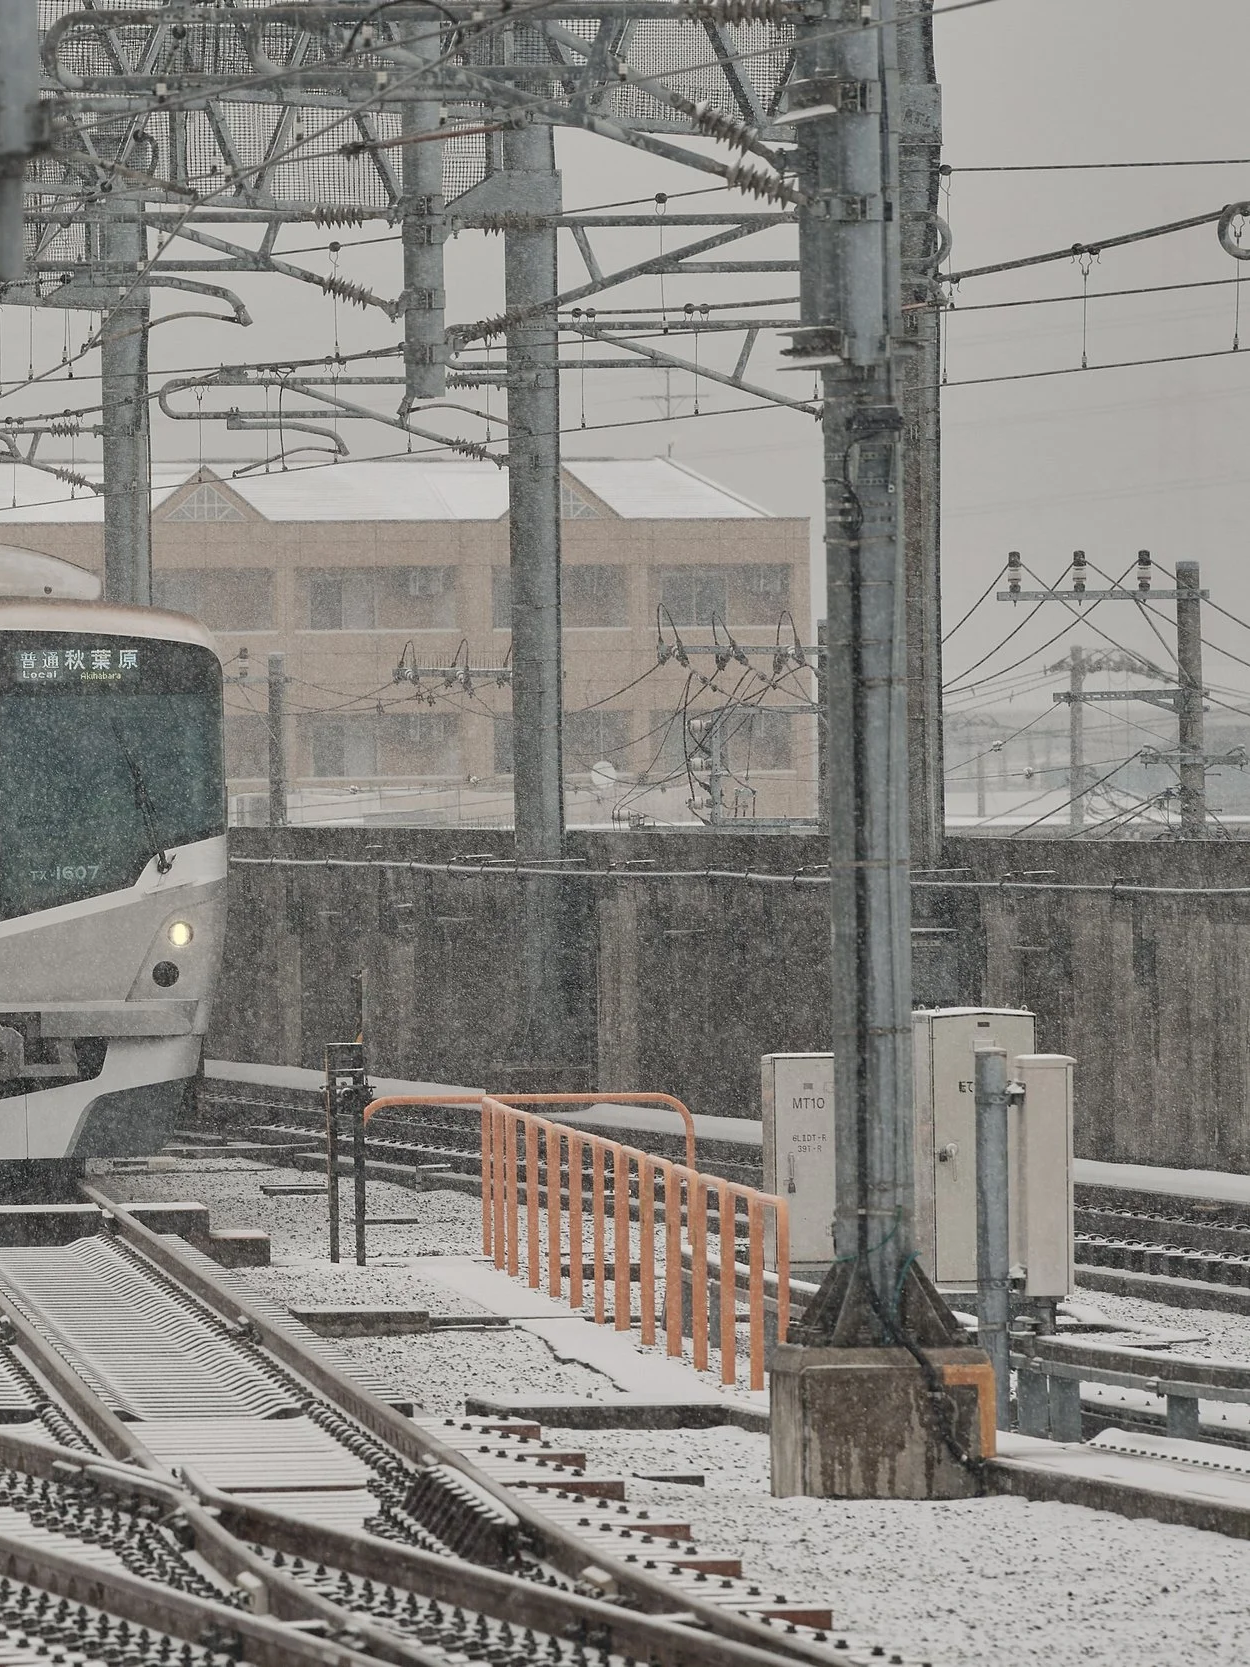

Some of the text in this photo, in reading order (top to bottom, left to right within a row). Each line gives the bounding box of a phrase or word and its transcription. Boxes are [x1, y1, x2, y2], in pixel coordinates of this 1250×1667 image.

[20, 649, 138, 670] 普通 秋葉原
[22, 670, 122, 681] Local Akihabara
[792, 1097, 825, 1109] MT10
